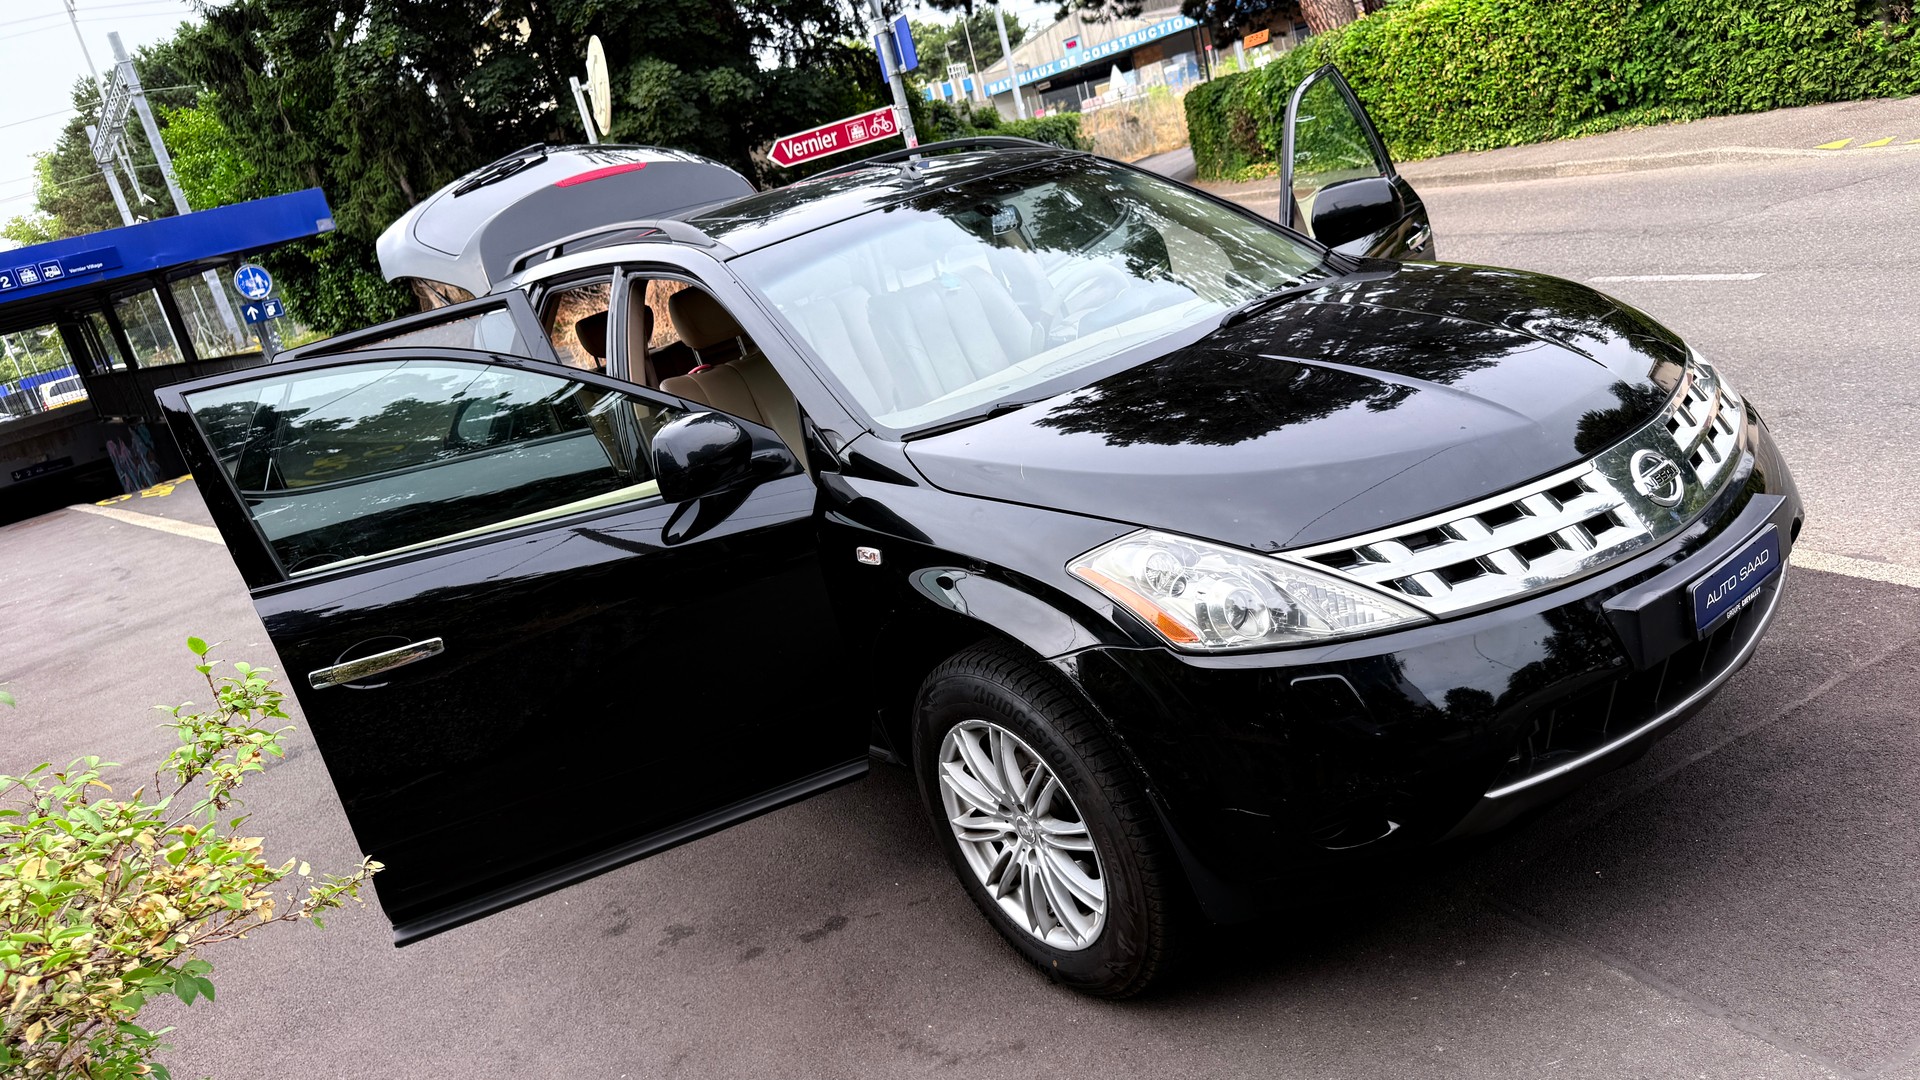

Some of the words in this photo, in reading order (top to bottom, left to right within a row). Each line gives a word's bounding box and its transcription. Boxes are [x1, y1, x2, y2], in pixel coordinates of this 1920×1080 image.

[989, 64, 1055, 94] MATRIAUX
[1060, 55, 1077, 69] DE
[781, 130, 838, 160] Vernier
[0, 276, 12, 288] 2
[1645, 466, 1678, 492] NISSAN
[1706, 575, 1737, 609] AUTO
[1740, 549, 1769, 581] SAAD
[972, 684, 1089, 793] BRIDGESTONE
